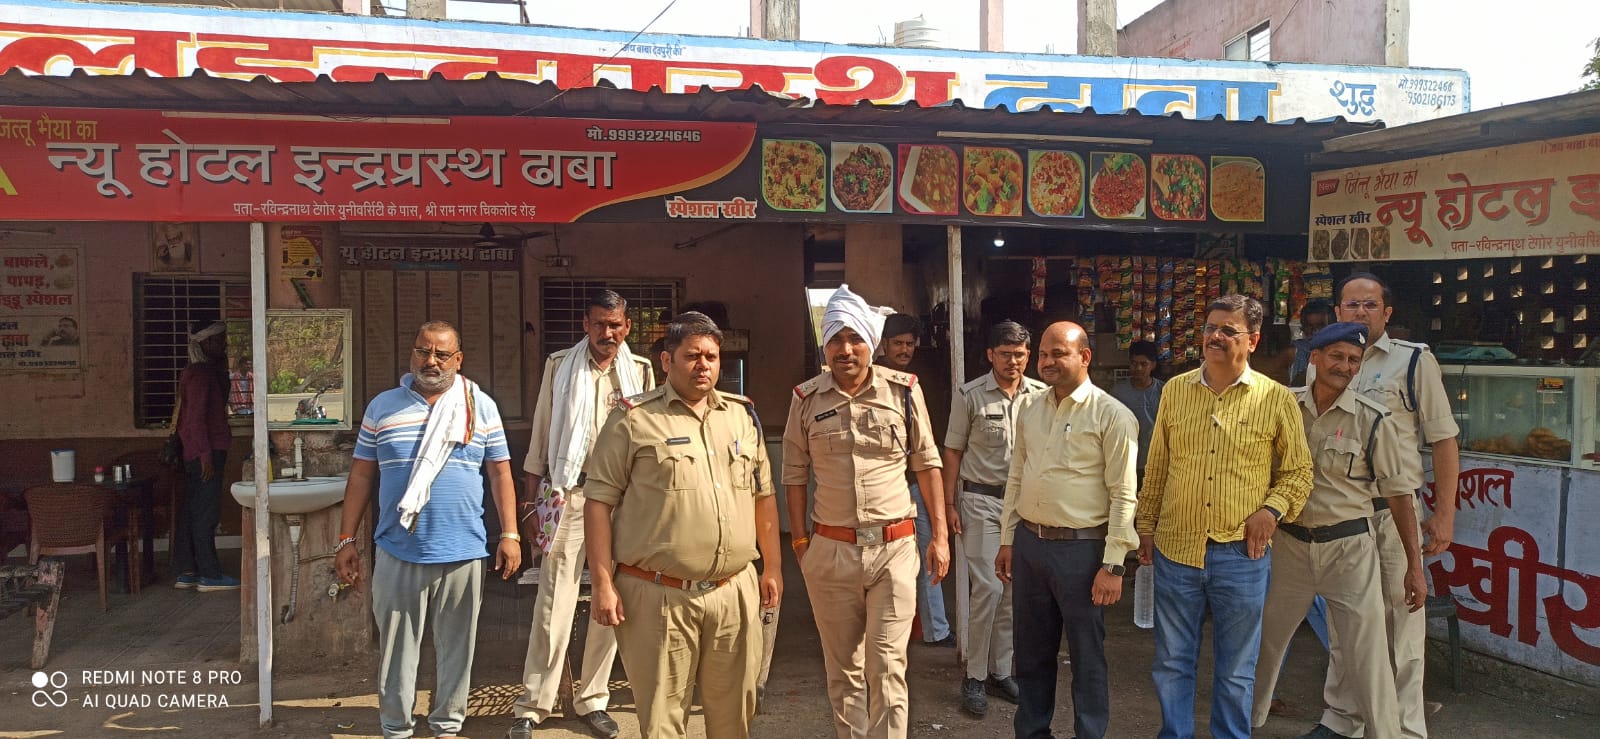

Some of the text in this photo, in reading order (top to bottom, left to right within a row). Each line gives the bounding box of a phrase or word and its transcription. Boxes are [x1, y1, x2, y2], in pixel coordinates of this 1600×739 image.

[37, 112, 72, 140] भैया
[76, 120, 98, 140] का
[46, 129, 616, 197] न्यू होटल इन्द्रप्रस्थ ढाबा
[313, 201, 336, 216] टेगोर
[388, 202, 398, 216] के
[425, 201, 437, 217] श्री
[440, 205, 455, 217] राम
[458, 205, 477, 217] नगर
[480, 201, 517, 217] चिकलोद
[666, 196, 758, 219] स्पेशल खीर
[1315, 211, 1371, 226] स्पेशल खीर
[1375, 192, 1432, 247] न्यू
[1436, 173, 1557, 231] होटल
[360, 242, 407, 261] होटल
